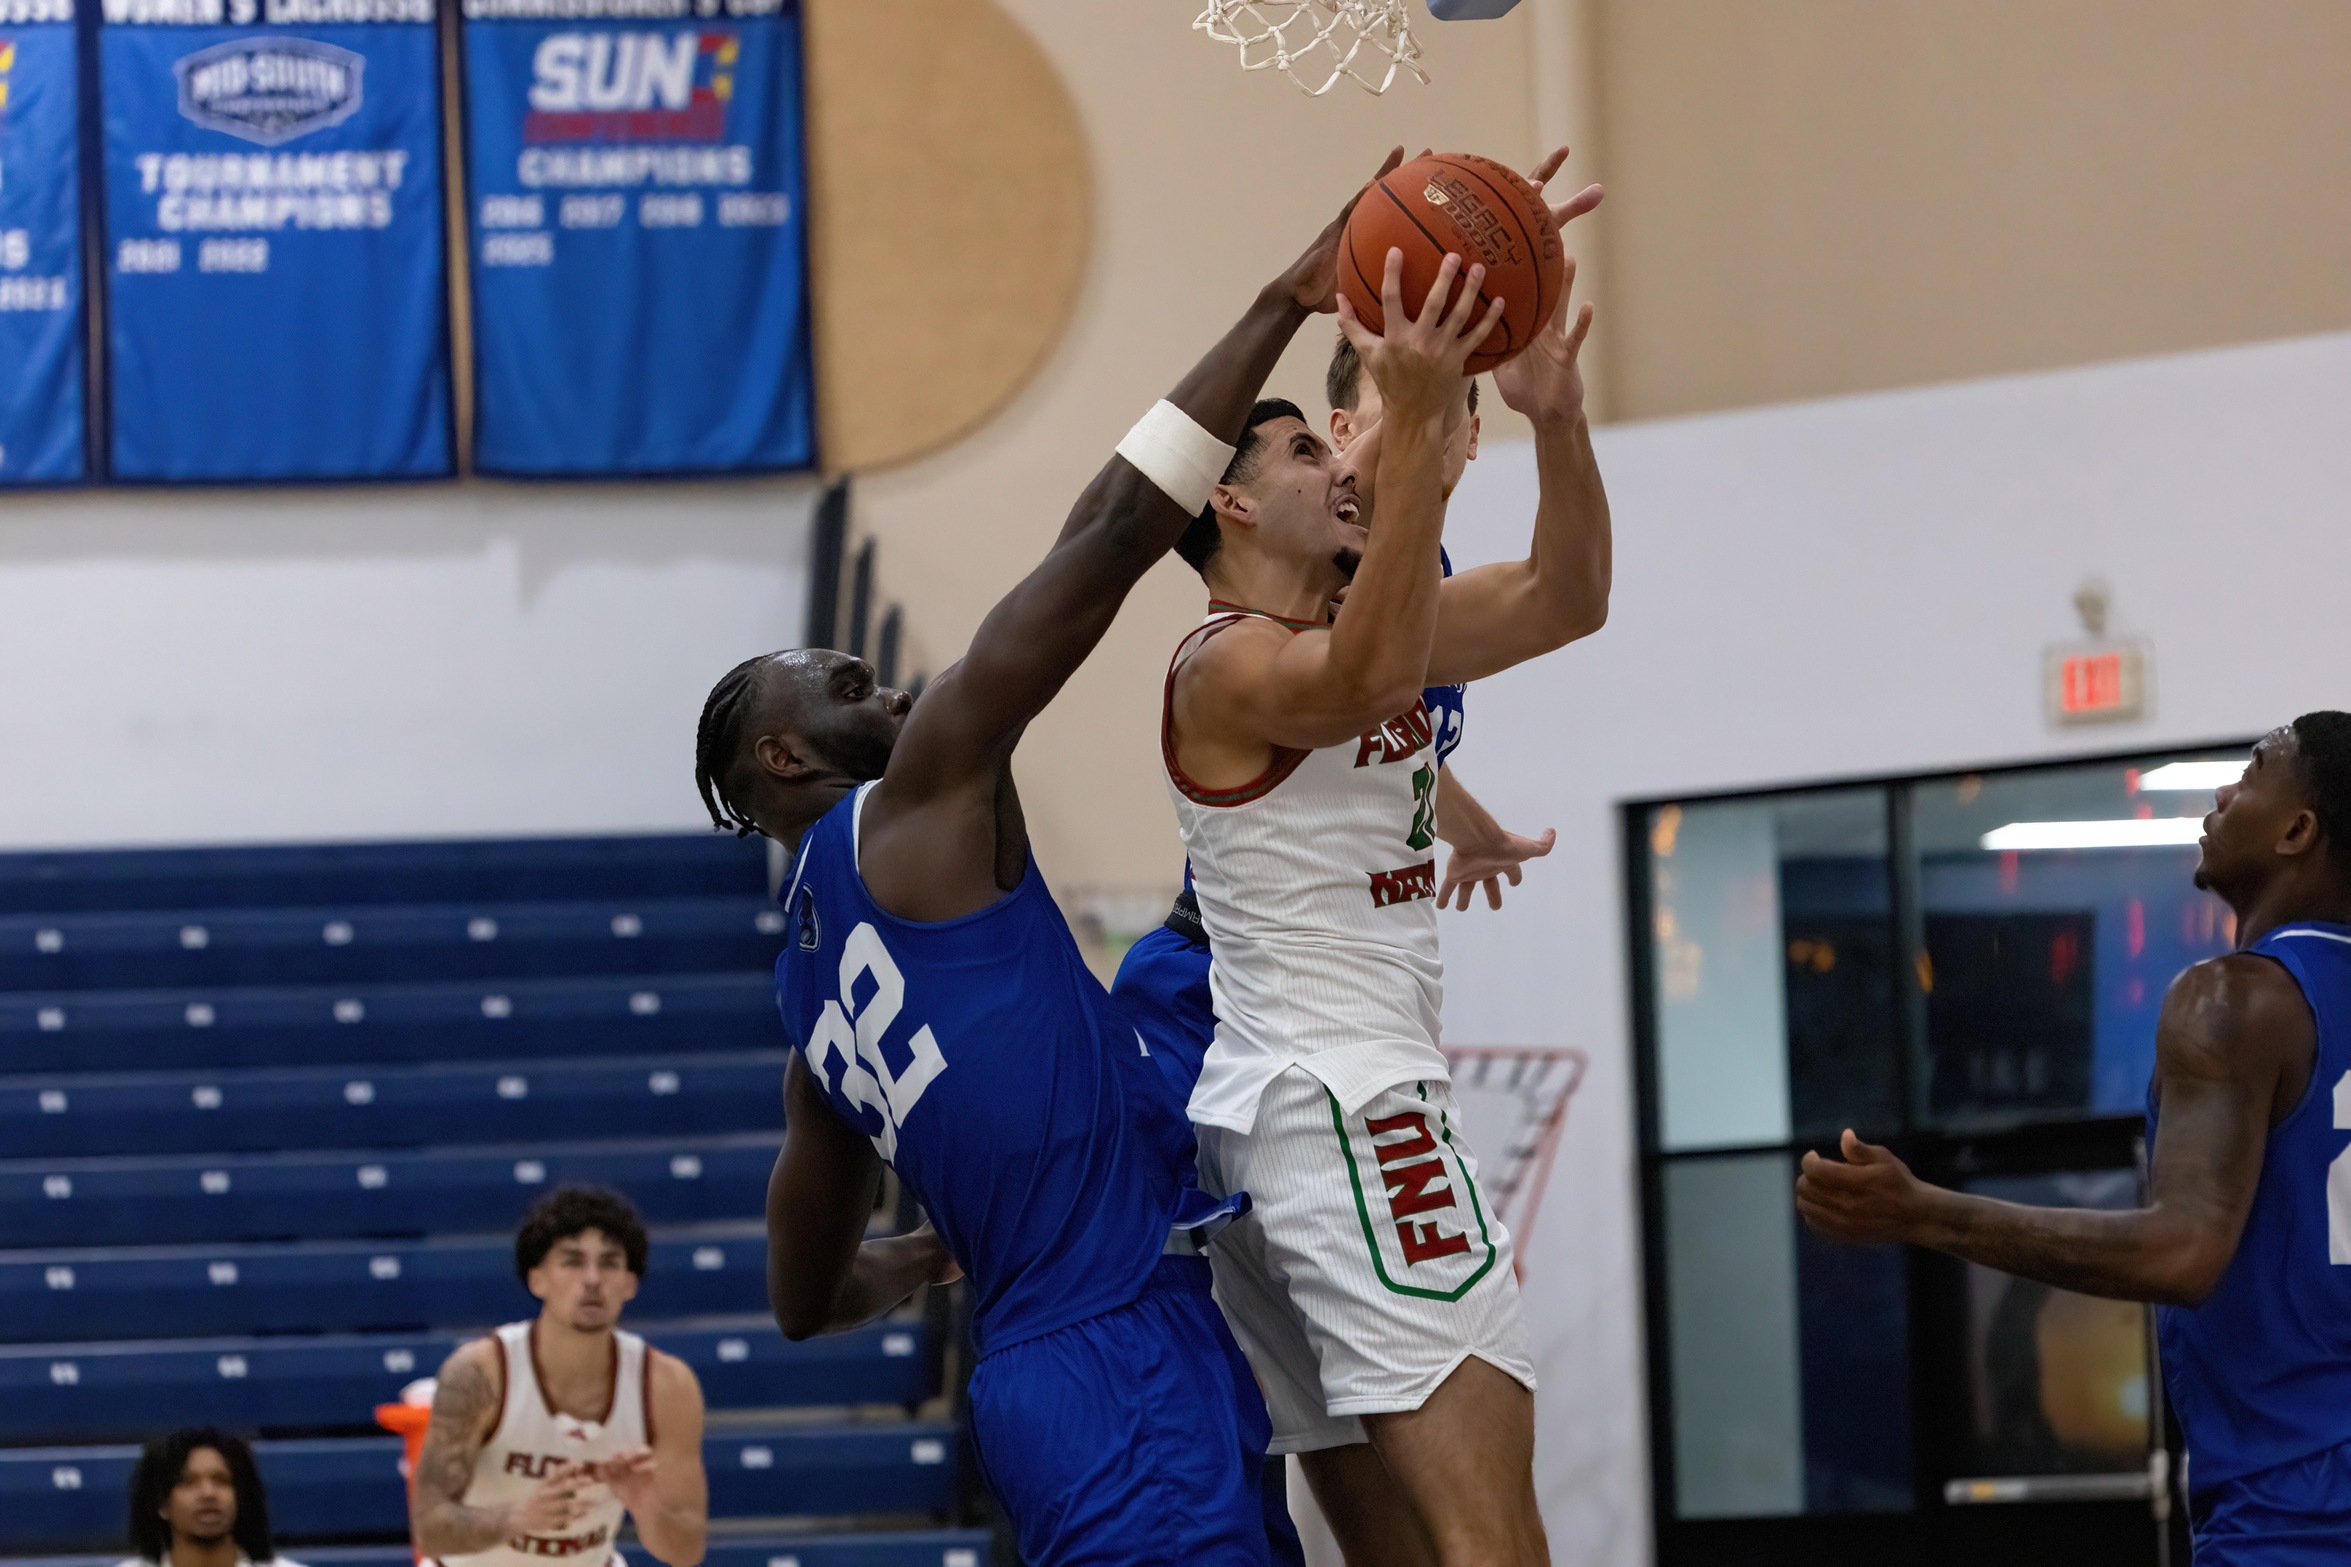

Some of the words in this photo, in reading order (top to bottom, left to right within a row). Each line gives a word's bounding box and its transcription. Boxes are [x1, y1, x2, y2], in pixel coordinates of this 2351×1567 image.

[528, 32, 697, 112] SUN
[136, 150, 407, 193] TOURNAMENT
[518, 145, 752, 187] CHAMPIONS
[157, 192, 392, 231] CHAMPIONS
[1430, 168, 1523, 267] LEGACY
[804, 921, 948, 1168] 32
[1364, 1111, 1472, 1269] FNU
